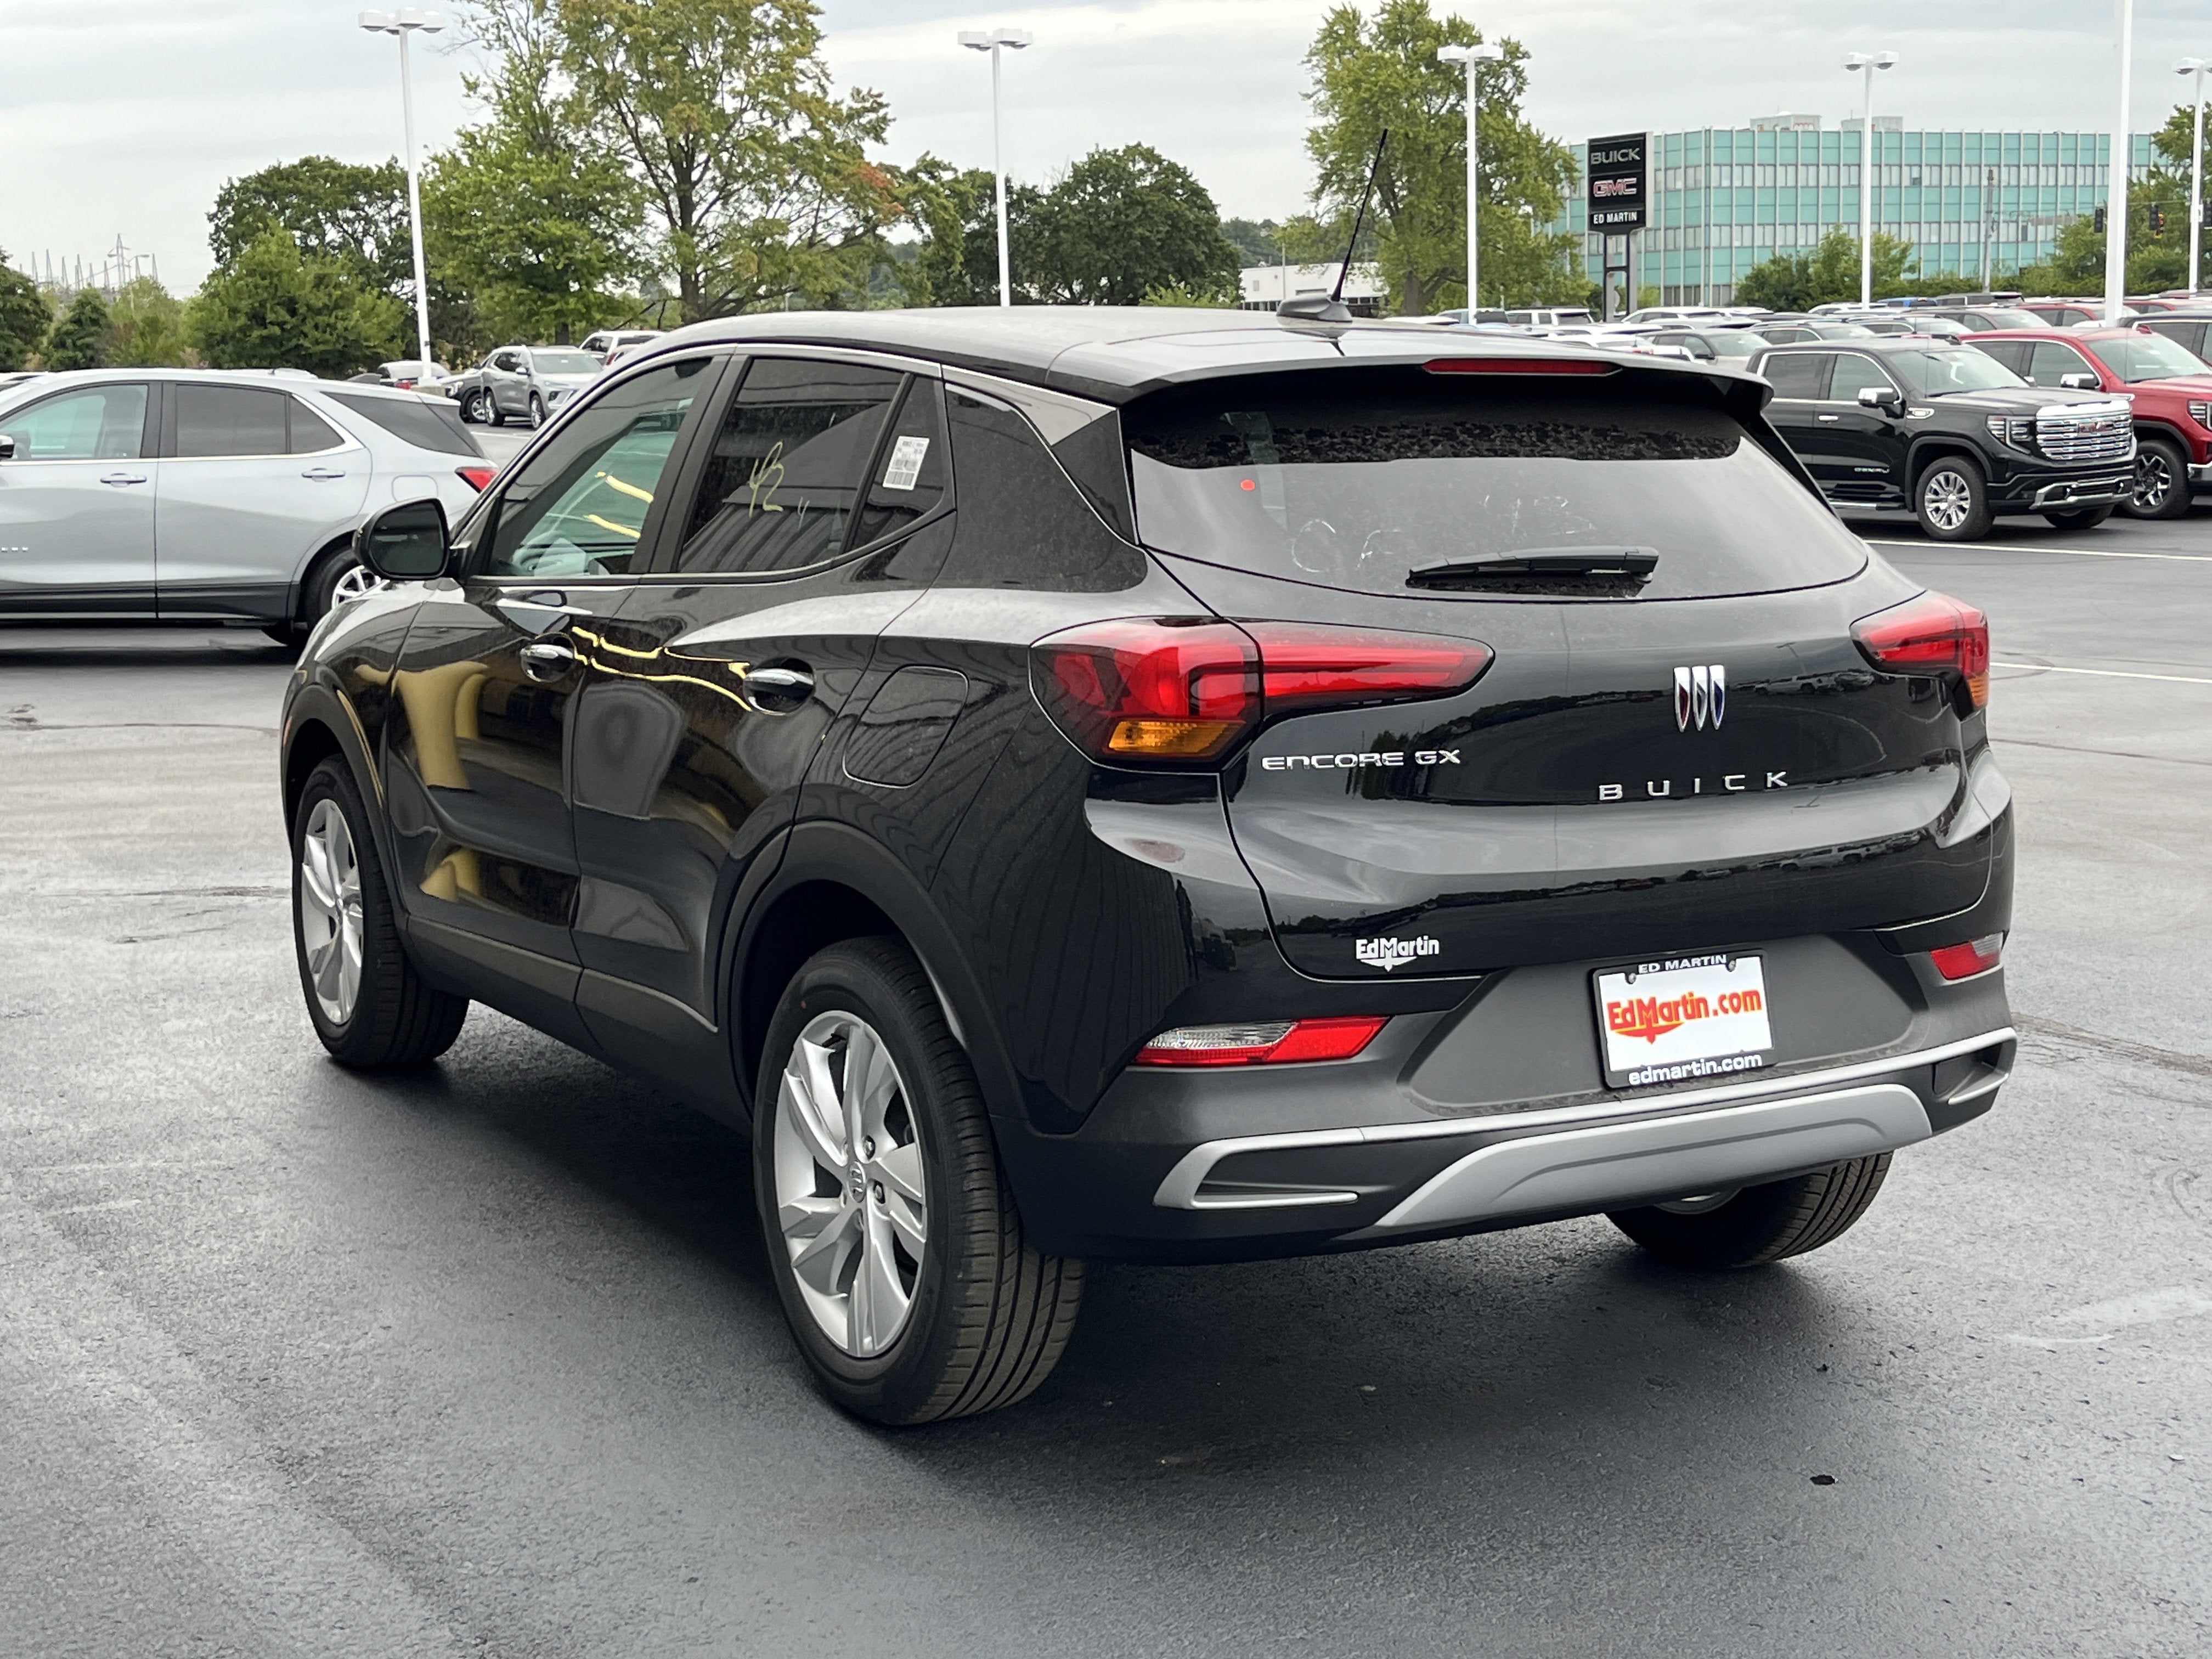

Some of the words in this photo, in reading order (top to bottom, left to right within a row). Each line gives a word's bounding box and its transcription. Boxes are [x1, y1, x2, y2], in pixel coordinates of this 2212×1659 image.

[1591, 148, 1640, 165] BUICK
[1593, 178, 1637, 198] GMC
[1594, 214, 1604, 224] ED
[1606, 212, 1637, 223] MARTIN
[1262, 752, 1404, 770] ENCORE
[1415, 749, 1460, 765] GX
[1599, 771, 1787, 801] BUICK
[1356, 935, 1440, 966] EdMartin
[1638, 964, 1661, 974] ED
[1665, 955, 1726, 970] MARTIN
[1628, 1054, 1762, 1085] edmartin.com
